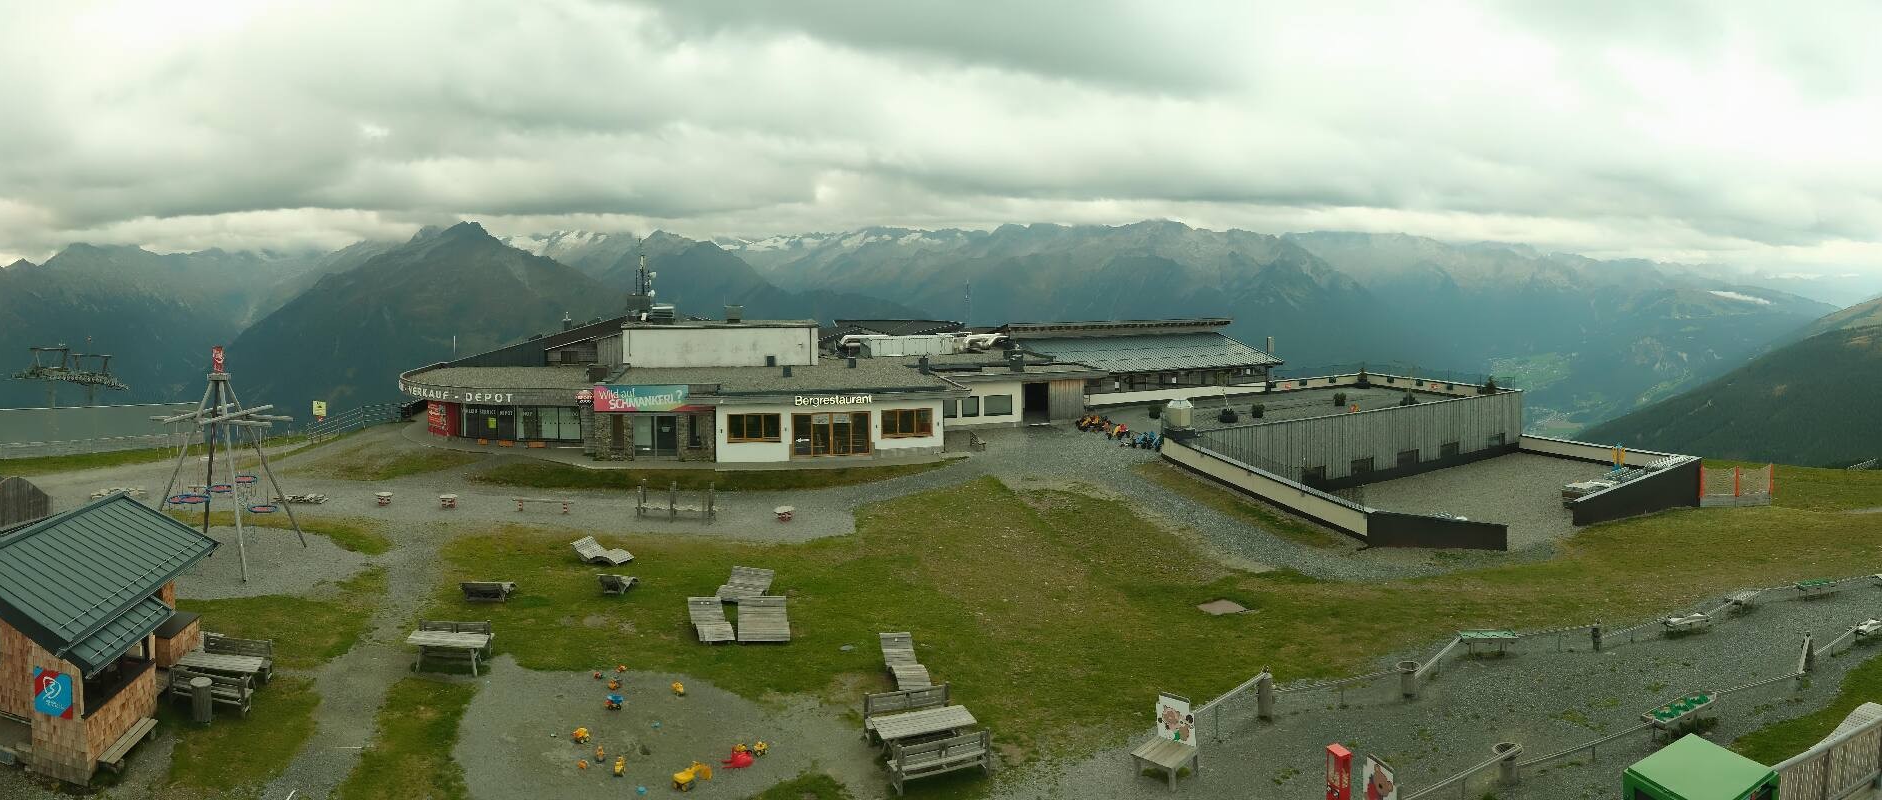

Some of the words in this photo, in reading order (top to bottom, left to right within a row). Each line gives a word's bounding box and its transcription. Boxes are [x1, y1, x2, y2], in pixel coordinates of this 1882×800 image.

[408, 386, 449, 400] VERKAUF
[465, 393, 513, 402] DEPOT
[598, 388, 619, 400] Wild
[621, 387, 636, 398] auf
[795, 394, 872, 407] Bergrestaurant
